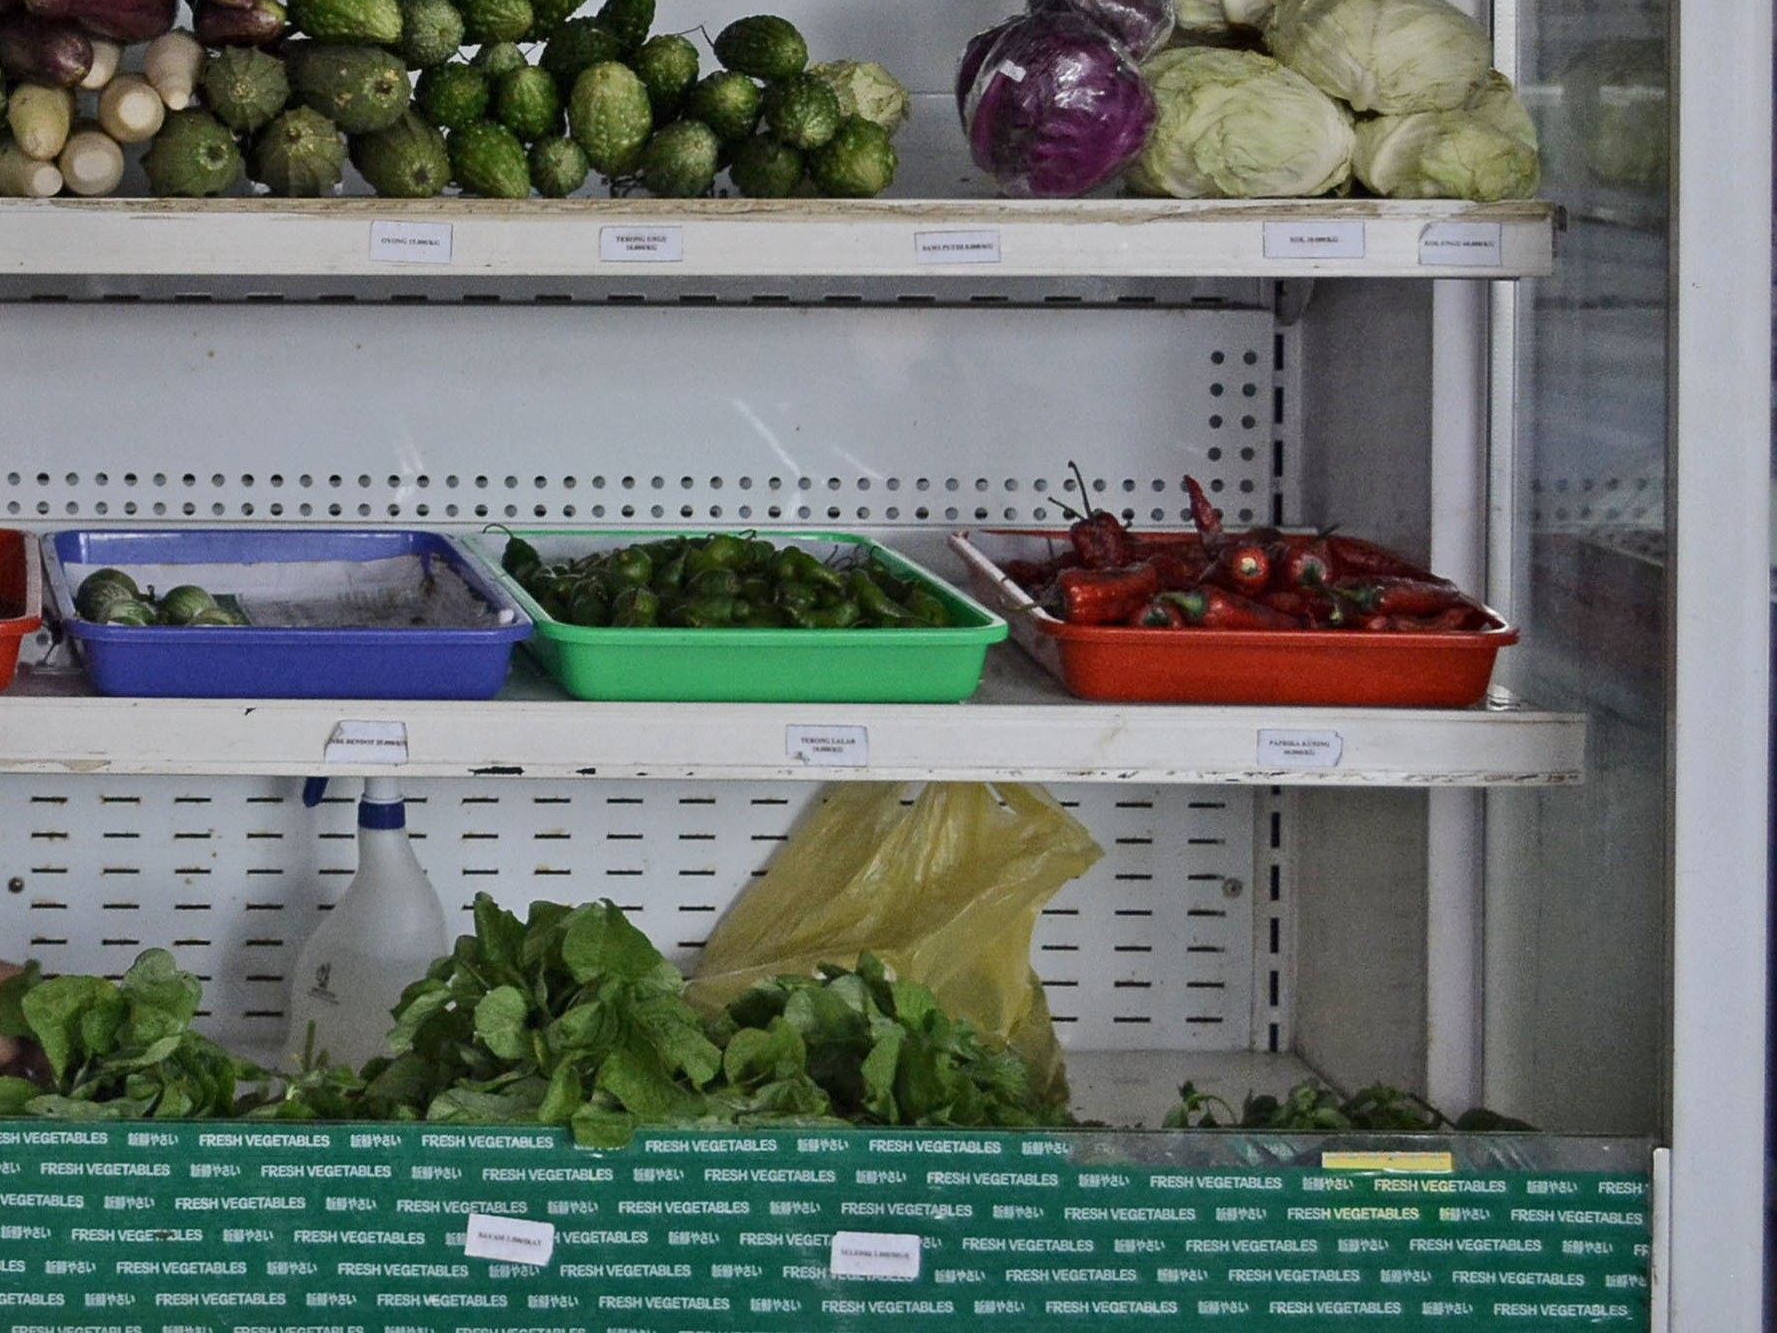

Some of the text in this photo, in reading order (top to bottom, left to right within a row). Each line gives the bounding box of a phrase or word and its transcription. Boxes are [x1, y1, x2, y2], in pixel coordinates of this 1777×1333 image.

[22, 1131, 109, 1145] VEGETABLES
[198, 1133, 331, 1148] FRESH VEGETABLES
[421, 1134, 555, 1149] FRESH VEGETABLES
[645, 1139, 778, 1153] FRESH VEGETABLES
[869, 1139, 1002, 1154] FRESH VEGETABLES
[40, 1162, 171, 1176] FRESH VEGETABLES
[260, 1164, 392, 1178] FRESH VEGETABLES
[482, 1168, 614, 1181] FRESH VEGETABLES
[704, 1168, 836, 1183] FRESH VEGETABLES
[926, 1171, 1059, 1186] FRESH VEGETABLES
[1150, 1175, 1283, 1190] FRESH VEGETABLES
[1374, 1178, 1507, 1193] FRESH VEGETABLES
[0, 1193, 85, 1208] VEGETABLES
[174, 1196, 306, 1210] FRESH VEGETABLES
[618, 1201, 750, 1214] FRESH VEGETABLES
[841, 1202, 973, 1218] FRESH VEGETABLES
[1064, 1207, 1196, 1221] FRESH VEGETABLES
[1287, 1207, 1420, 1221] FRESH VEGETABLES
[71, 1228, 203, 1242] FRESH VEGEBLES
[293, 1230, 426, 1245] FRESH VEGETABLES
[962, 1237, 1094, 1252] FRESH VEGETABLES
[1185, 1239, 1318, 1252] FRESH VEGETABLES
[1409, 1238, 1543, 1252] FRESH VEGETABLES
[116, 1261, 247, 1275] FRESH VEGETABLES
[337, 1262, 469, 1277] FRESH VEGETABLES
[559, 1264, 692, 1277] FRESH VEGETABLES
[1005, 1269, 1137, 1282] FRESH VEGETABLES
[1228, 1269, 1361, 1282] FRESH VEGETABLES
[1452, 1270, 1585, 1286] FRESH VEGETABLES
[155, 1292, 287, 1306] FRESH VEGETABLES
[377, 1293, 508, 1307] FRESH VEGETABLES
[821, 1300, 954, 1314] FRESH VEGETABLES
[1045, 1301, 1178, 1314] FRESH VEGETABLES
[1269, 1301, 1402, 1314] FRESH VEGETABLES
[1493, 1303, 1628, 1317] FRESH VEGETABLES
